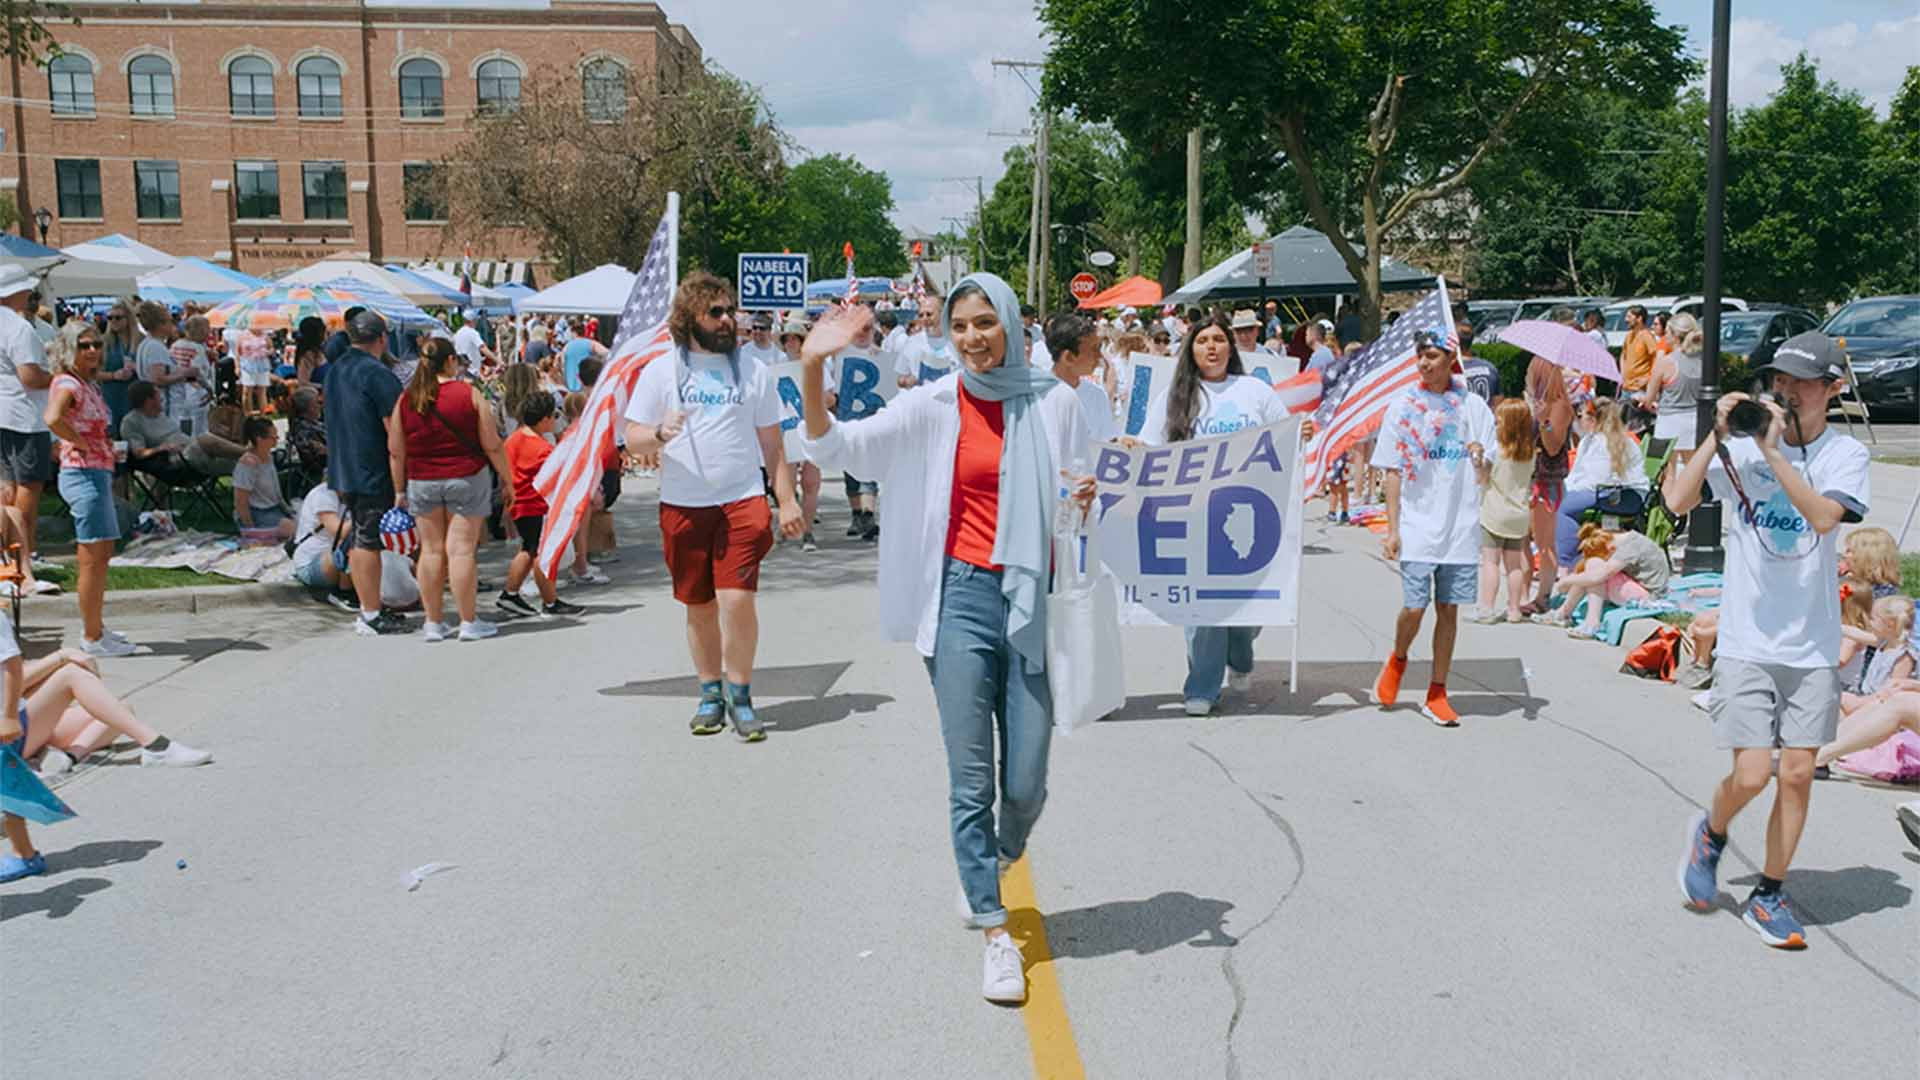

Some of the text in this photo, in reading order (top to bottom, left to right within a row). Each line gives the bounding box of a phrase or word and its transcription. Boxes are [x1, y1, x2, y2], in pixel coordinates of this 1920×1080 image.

[743, 260, 802, 272] NABEELA
[743, 275, 802, 296] SYED
[1073, 281, 1093, 292] STOP
[838, 357, 886, 422] B
[1096, 430, 1283, 486] BEELA
[1168, 585, 1191, 604] 51
